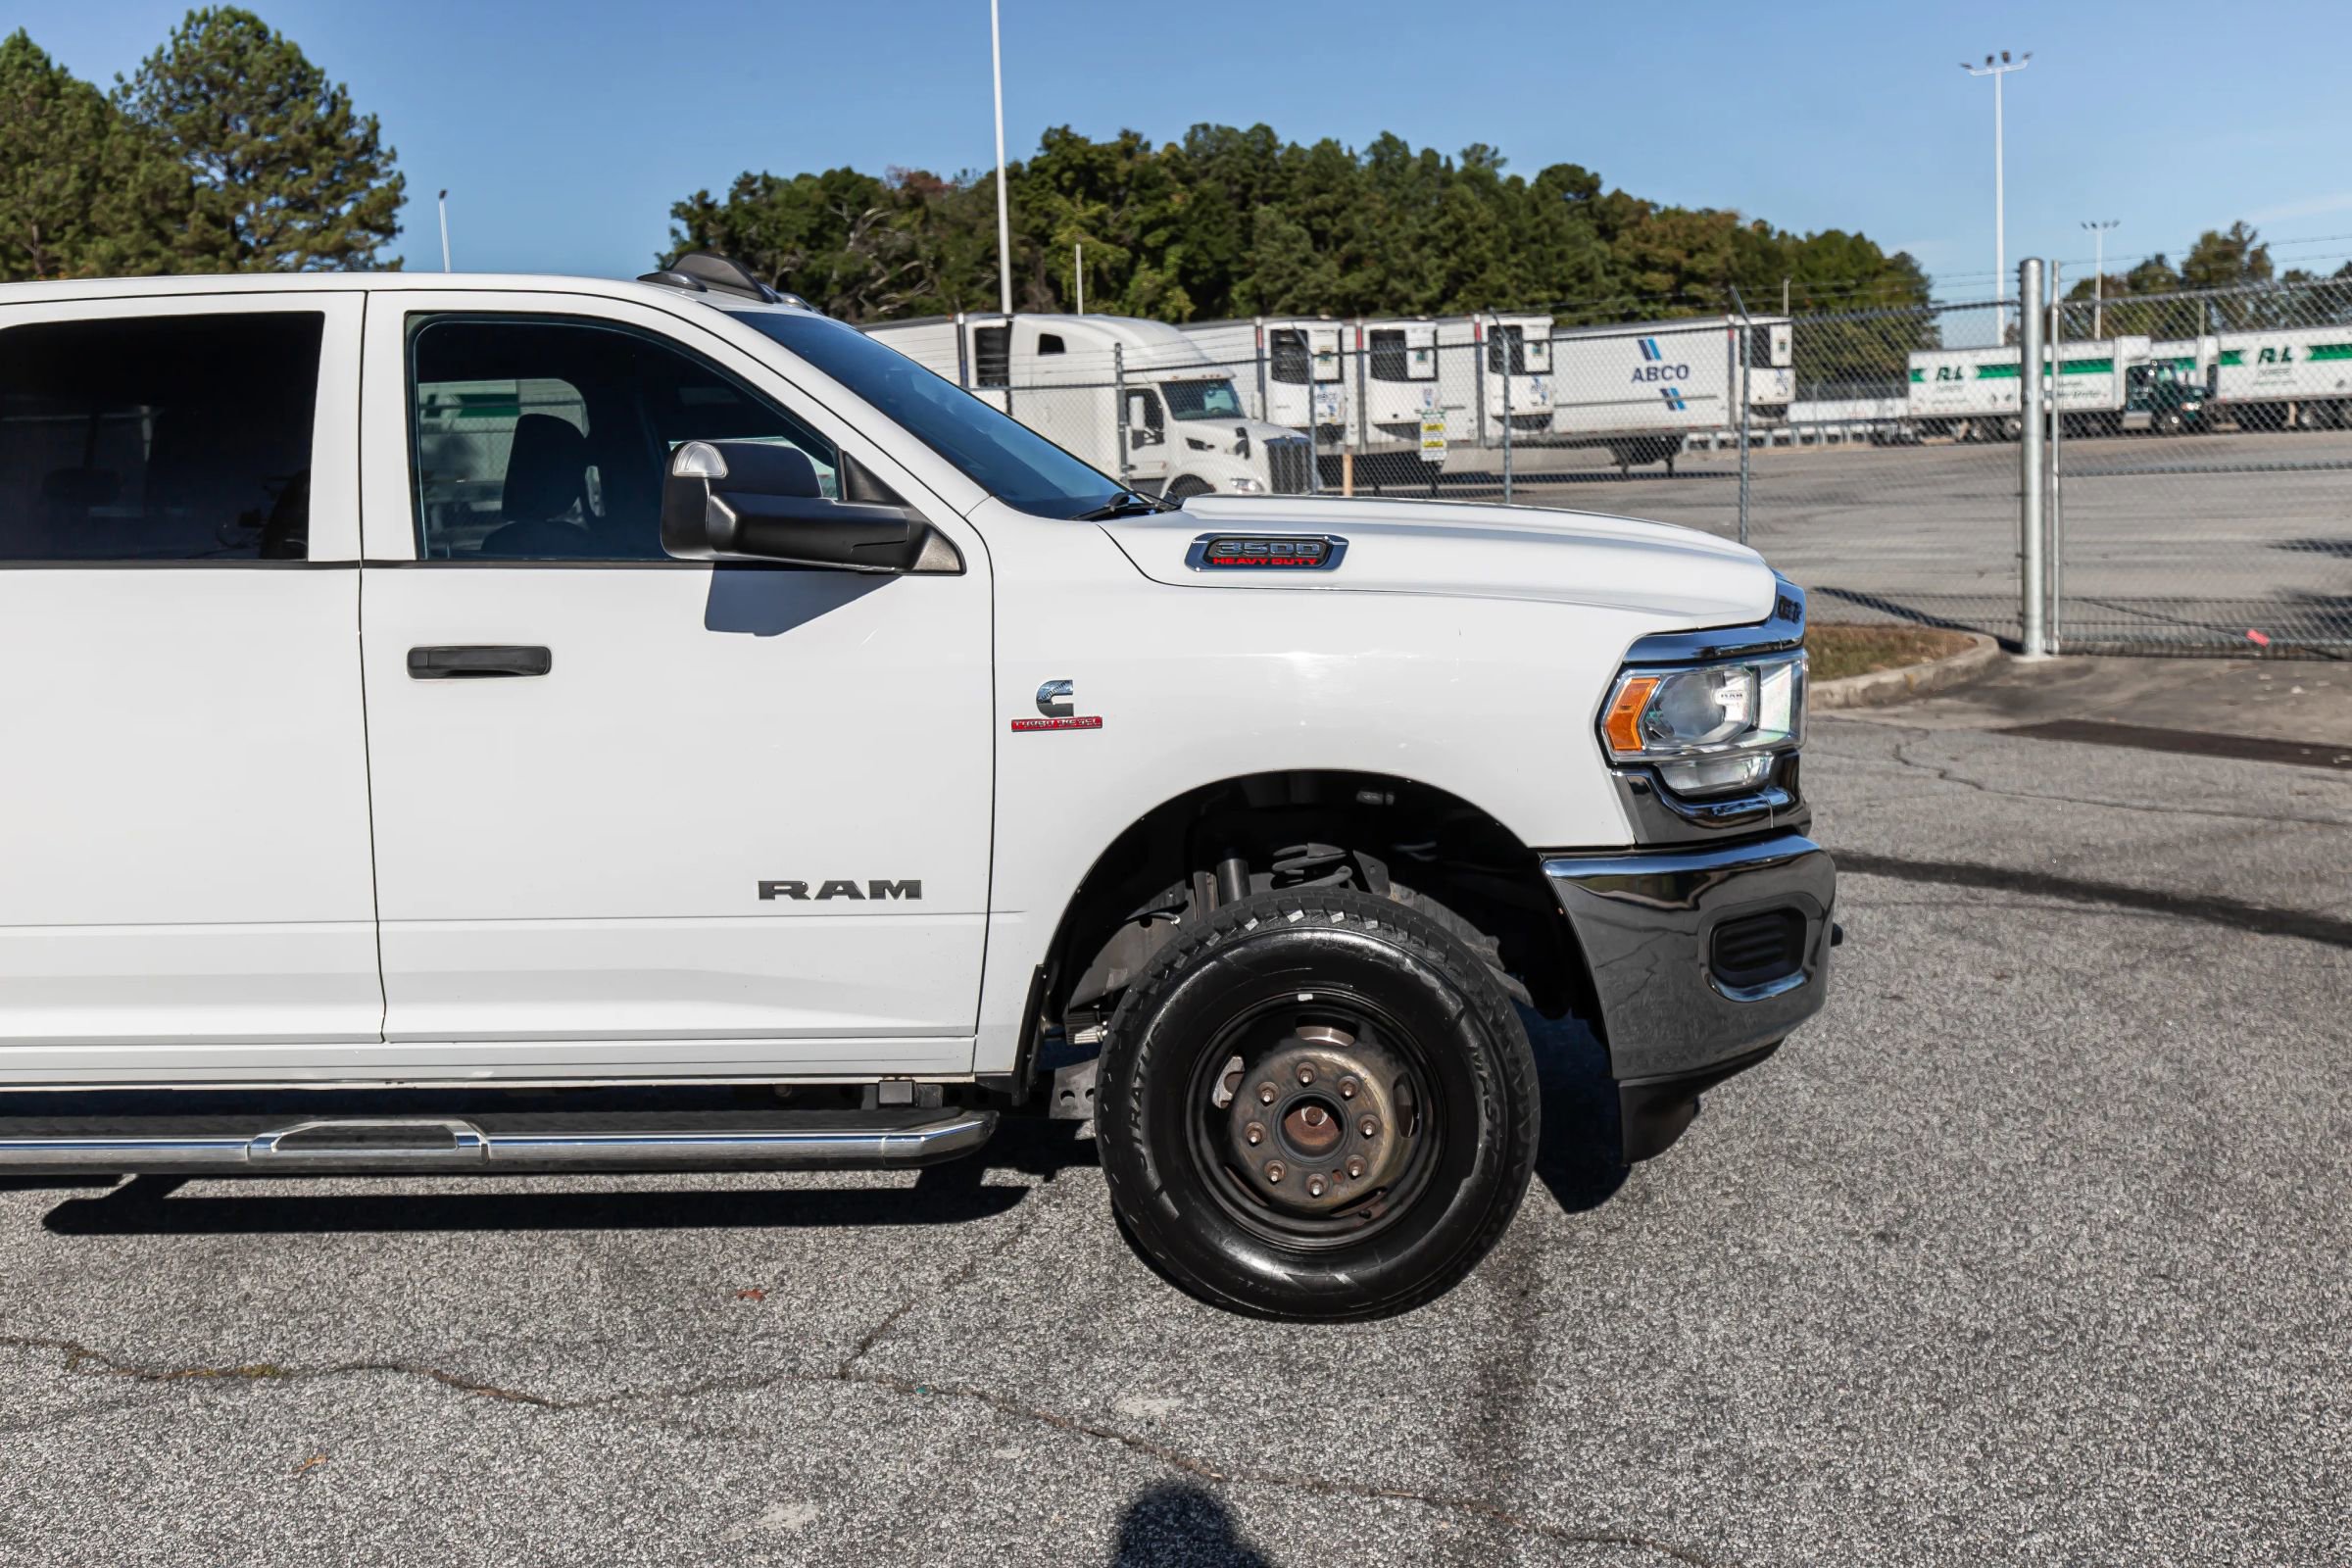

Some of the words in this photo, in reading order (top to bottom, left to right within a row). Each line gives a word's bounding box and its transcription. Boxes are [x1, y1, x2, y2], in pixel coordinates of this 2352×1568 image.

[1631, 365, 1690, 383] ABCO
[1216, 542, 1321, 557] 3500
[1213, 557, 1268, 565] HEAVY
[1271, 557, 1318, 565] DUTY
[758, 880, 922, 901] RAM
